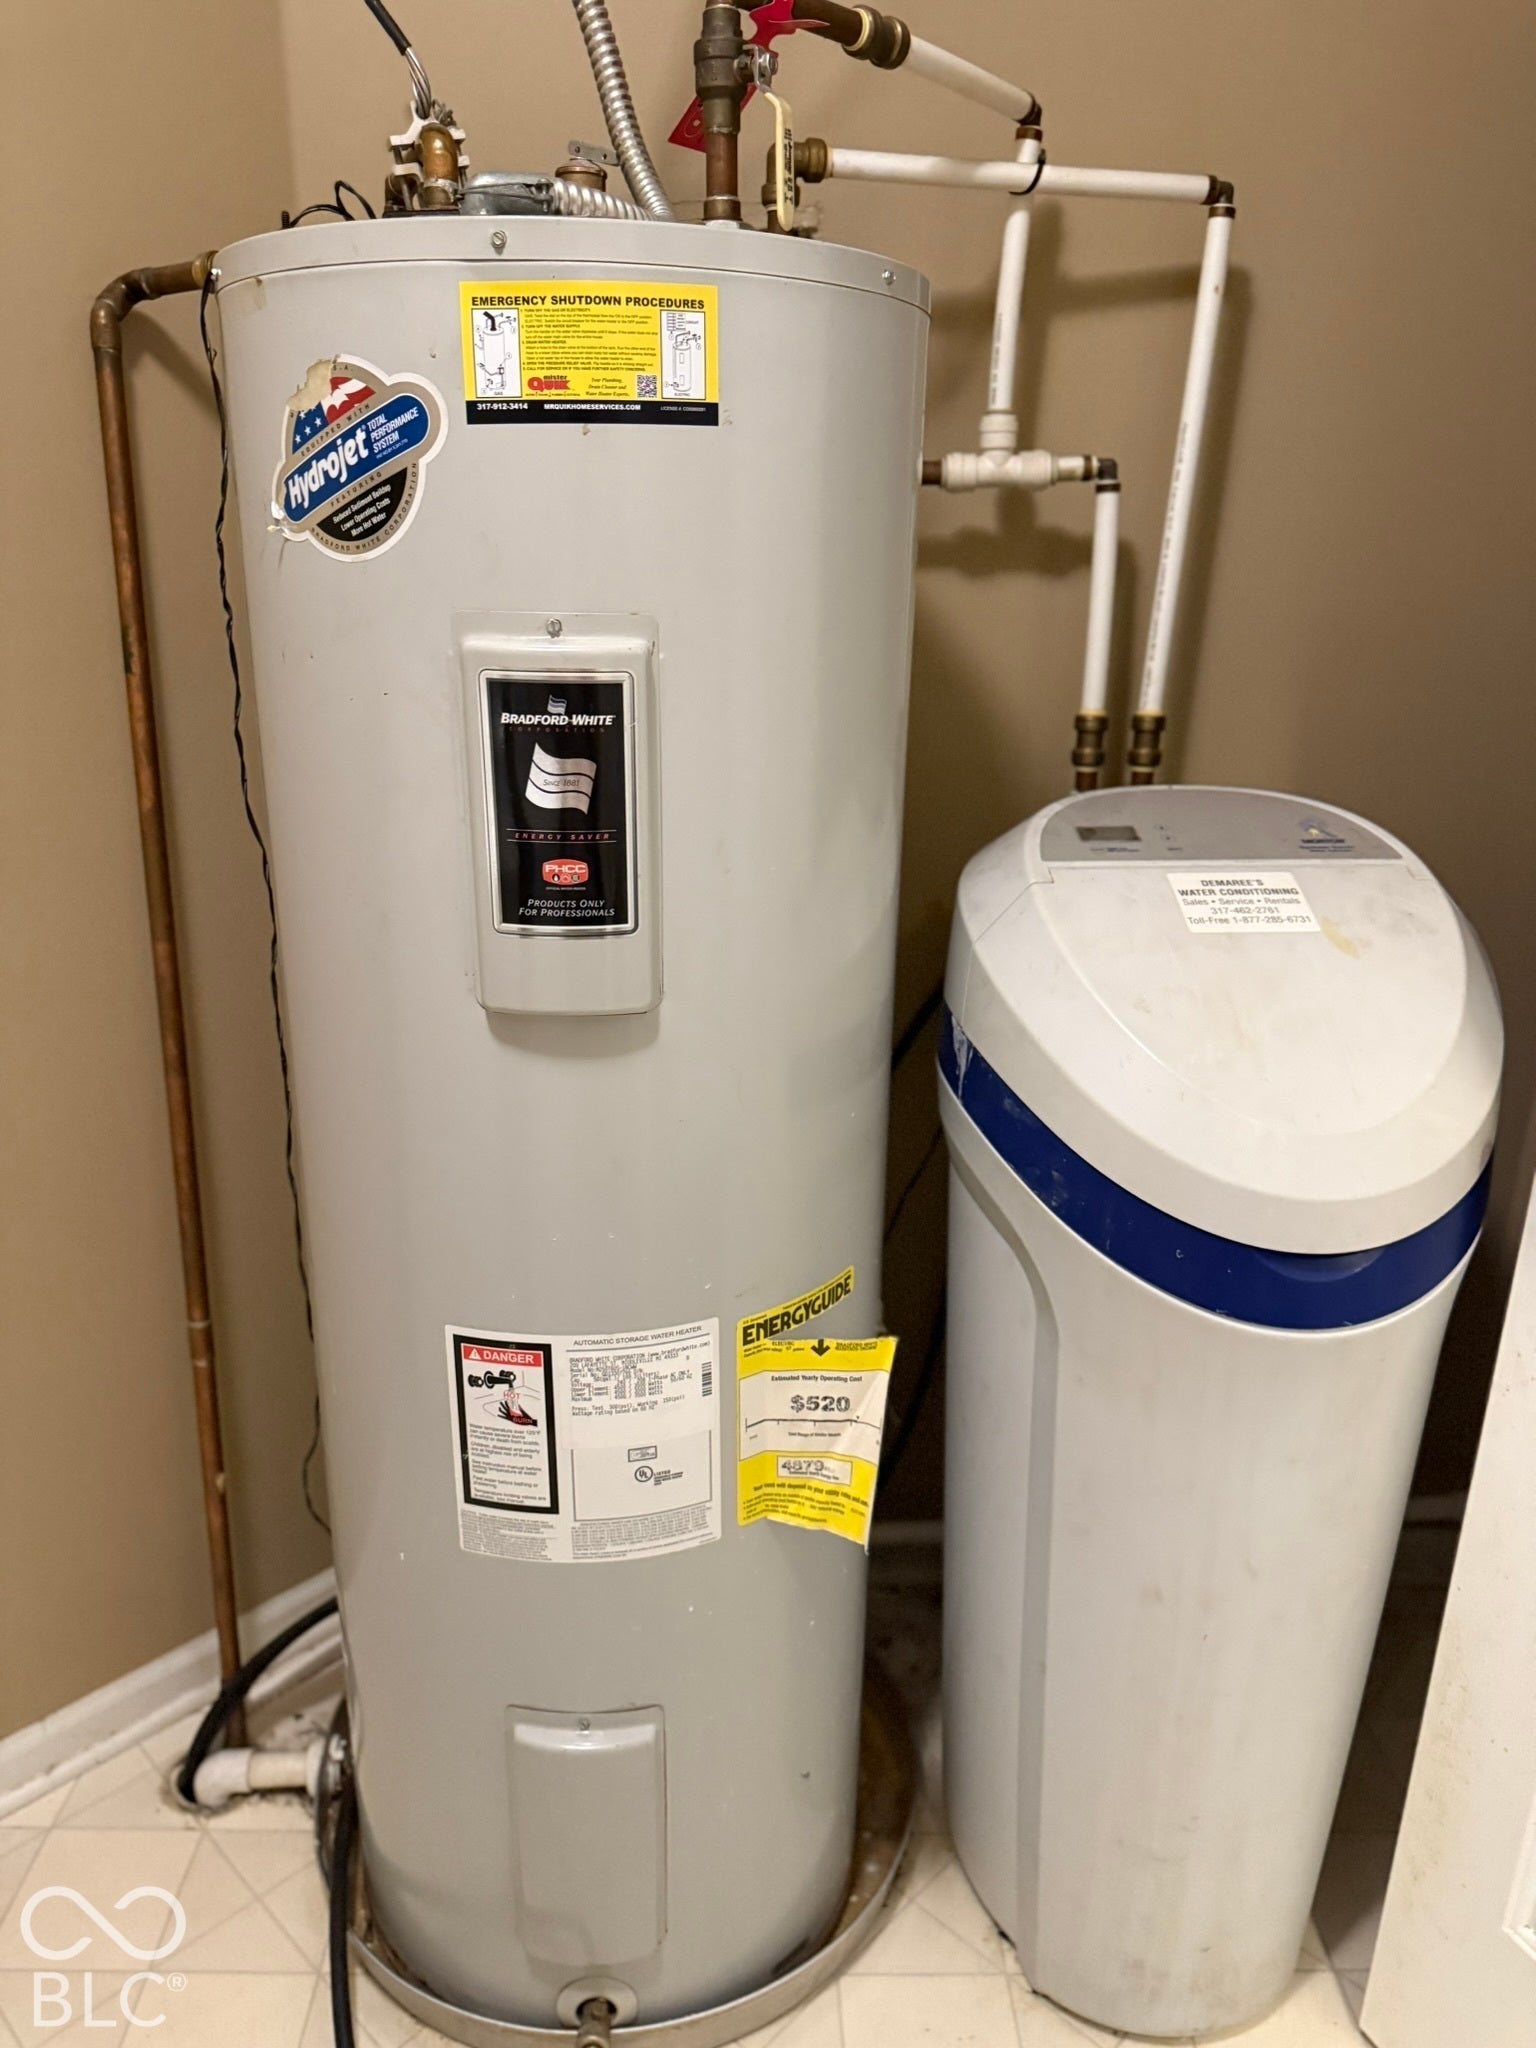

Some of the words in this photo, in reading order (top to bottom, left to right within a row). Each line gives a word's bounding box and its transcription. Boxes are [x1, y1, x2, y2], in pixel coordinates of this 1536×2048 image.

[472, 296, 547, 306] EMERGENCY
[551, 296, 622, 306] SHUTDOWN
[626, 296, 704, 310] PROCEDURES
[301, 423, 341, 456] EQUIPPED
[346, 404, 370, 421] WITH
[367, 413, 388, 431] TOTAL
[370, 406, 419, 442] PERFORMANCE
[373, 430, 400, 453] SYSTEM
[288, 427, 369, 509] Hydrojet
[331, 472, 382, 506] FEATURING
[340, 519, 355, 532] Lower
[354, 505, 377, 523] Operating
[376, 498, 391, 510] Costs
[355, 536, 380, 549] WHITE
[384, 463, 417, 535] CORPORATION
[350, 526, 364, 537] More
[363, 520, 373, 530] Hot
[371, 512, 387, 524] Water
[545, 864, 586, 873] PHCC
[1200, 879, 1264, 887] DEMAREE'S
[1220, 888, 1300, 896] CONDITIONING
[528, 899, 577, 908] PRODUCTS
[580, 900, 605, 908] ONLY
[518, 908, 537, 916] FOR
[540, 908, 615, 918] PROFESSIONALS
[1187, 916, 1230, 924] Toll-Free
[743, 1274, 852, 1346] ENERGYGUIDE
[573, 1338, 614, 1346] AUTOMATIC
[616, 1335, 649, 1344] STORAGE
[650, 1331, 675, 1340] WATER
[676, 1325, 702, 1336] HEATER
[483, 1350, 534, 1364] DANGER
[820, 1375, 848, 1383] Operating
[504, 1391, 520, 1400] HOT
[790, 1394, 851, 1414] $520
[639, 1469, 649, 1479] UL
